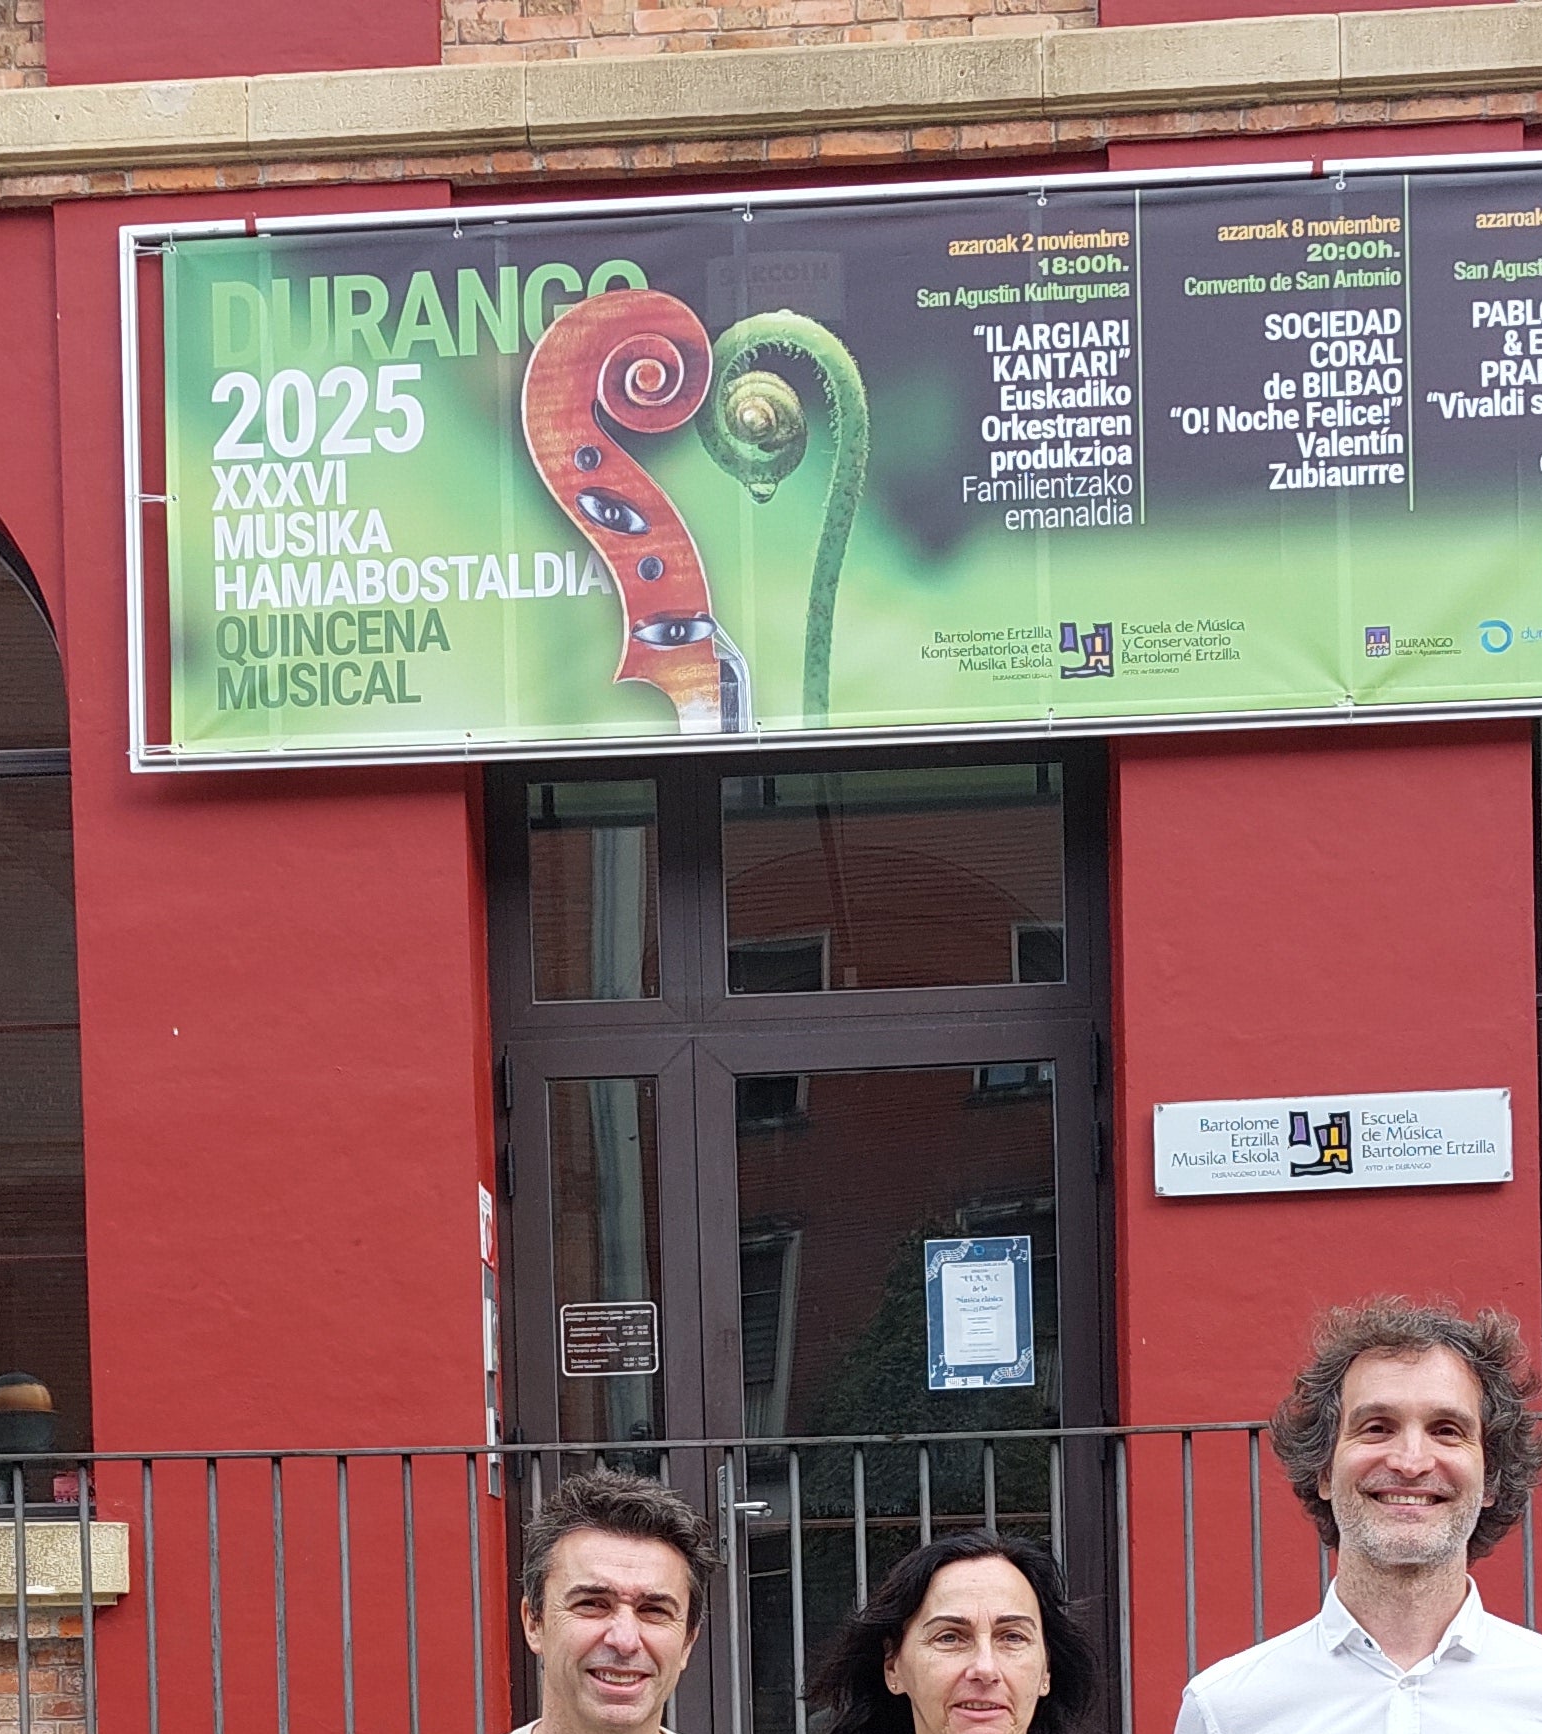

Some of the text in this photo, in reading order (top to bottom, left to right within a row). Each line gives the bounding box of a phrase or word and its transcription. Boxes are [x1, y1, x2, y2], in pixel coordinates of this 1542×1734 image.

[949, 229, 1129, 256] azaroak 2 noviembre
[1218, 215, 1400, 242] azaroak 8 noviembre
[1038, 256, 1129, 275] 18:00h.
[1307, 242, 1400, 262] 20:00h.
[1184, 267, 1401, 297] Convento de San Antonio
[1454, 260, 1489, 280] San
[917, 287, 952, 309] San
[1025, 279, 1130, 305] Kulturgunea
[1265, 309, 1402, 340] SOCIEDAD
[1310, 338, 1402, 368] CORAL
[1503, 330, 1523, 356] &
[1000, 382, 1132, 412] Euskadiko
[1264, 368, 1402, 400] de BILBAO
[211, 364, 425, 459] 2025
[1217, 403, 1299, 433] Noche
[982, 413, 1132, 442] Orkestraren
[1296, 427, 1403, 458] Valentín
[991, 443, 1132, 477] produkzioa
[211, 460, 347, 511] XXXVI
[963, 472, 1132, 503] Familientzako
[1269, 460, 1404, 490] Zubiaurrre
[1005, 500, 1133, 531] emanaldia
[214, 509, 391, 561] MUSIKA
[215, 551, 613, 611] HAMABOSTALDIA
[217, 608, 451, 662] QUINCENA
[935, 627, 1052, 645] Bartolome Ertzilla
[1121, 619, 1245, 635] Escuela de Música
[1031, 643, 1052, 653] eta
[1122, 634, 1230, 650] y Conservatorio
[1122, 648, 1240, 664] Bartolomé Ertzilla
[1396, 637, 1453, 648] DURANGO
[959, 656, 1053, 672] Musika Eskola
[218, 661, 421, 710] MUSICAL
[1199, 1116, 1280, 1132] Bartolome
[1361, 1109, 1418, 1126] Escuela
[1231, 1132, 1279, 1148] Ertzilla
[1362, 1125, 1443, 1142] de Música
[1171, 1148, 1280, 1167] Musika Eskola
[1362, 1140, 1496, 1158] Bartolome Ertzilla
